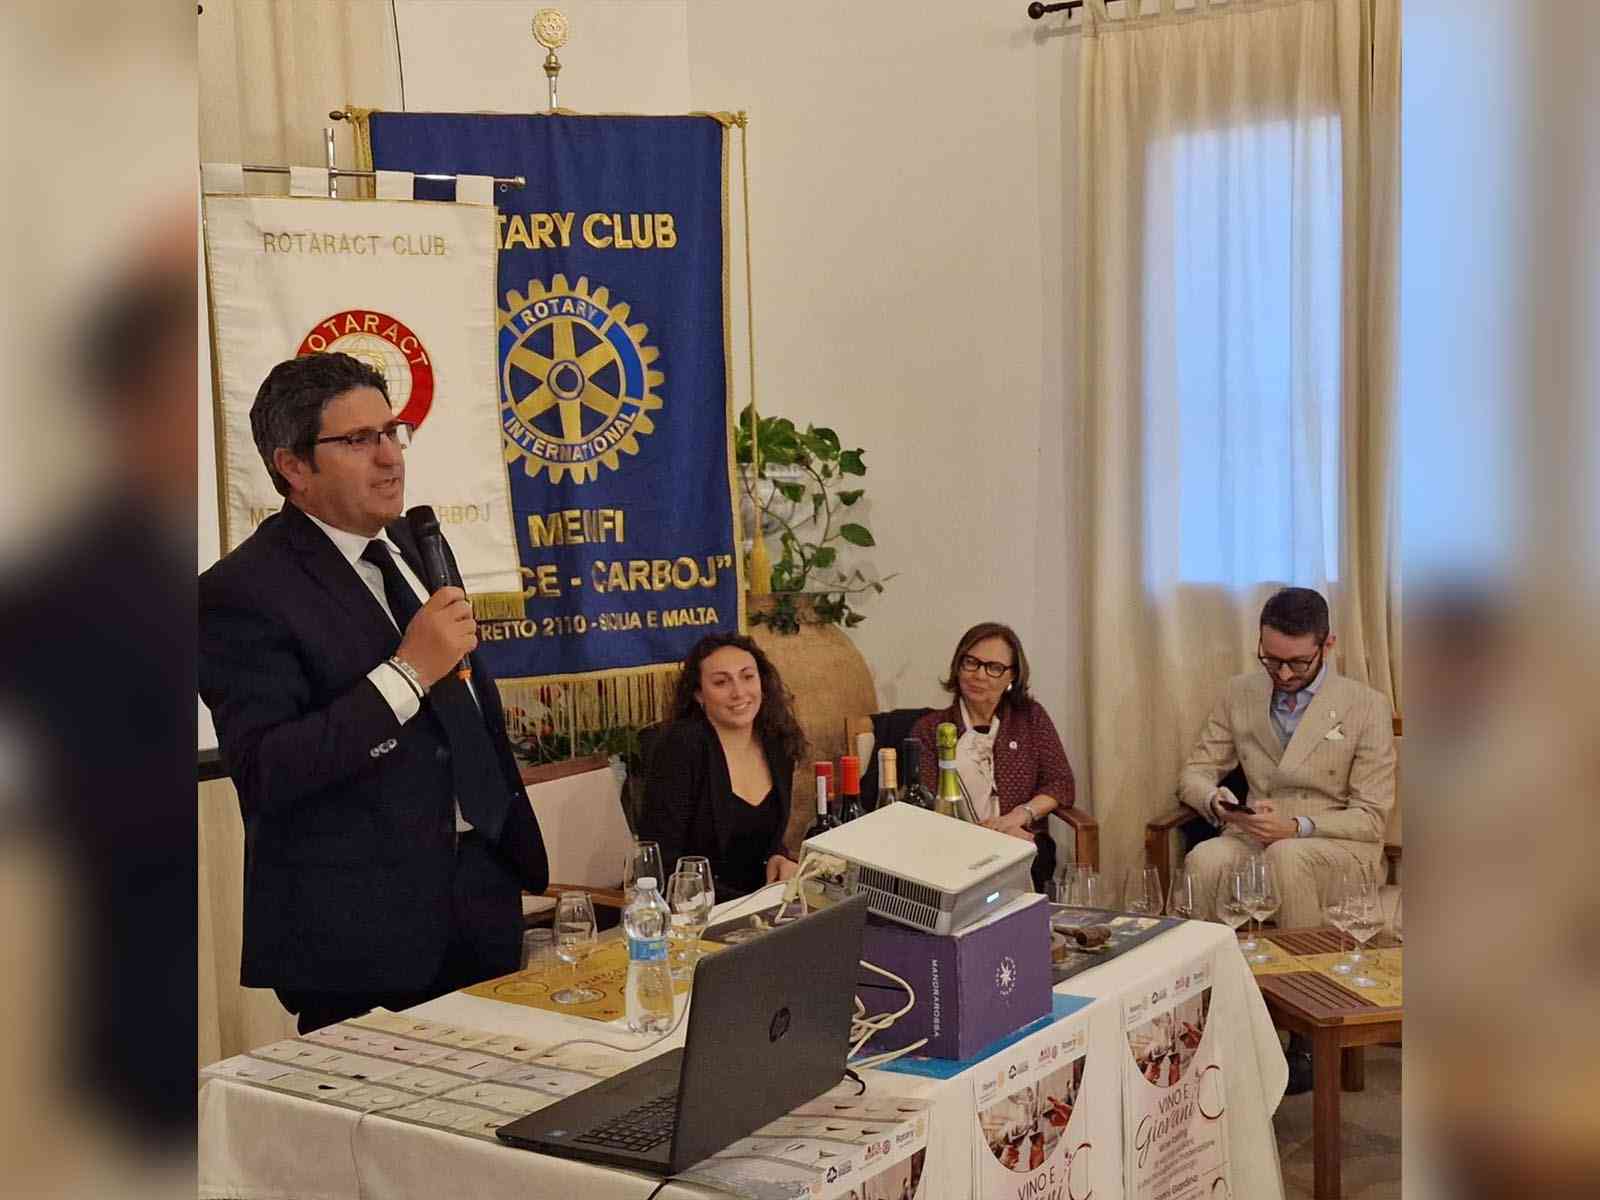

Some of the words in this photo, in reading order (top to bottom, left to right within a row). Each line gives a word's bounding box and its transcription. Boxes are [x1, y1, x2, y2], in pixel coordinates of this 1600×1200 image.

[263, 231, 380, 256] ROTARACT
[392, 235, 447, 256] CLUB
[496, 212, 576, 250] TARY
[582, 212, 678, 249] CLUB
[521, 298, 597, 328] ROTARY
[308, 313, 430, 367] OTARACT
[503, 409, 637, 462] INTERNATIONAL
[480, 619, 537, 641] RETTO
[542, 614, 586, 638] 2110
[647, 610, 657, 628] E
[662, 606, 719, 628] MALTA
